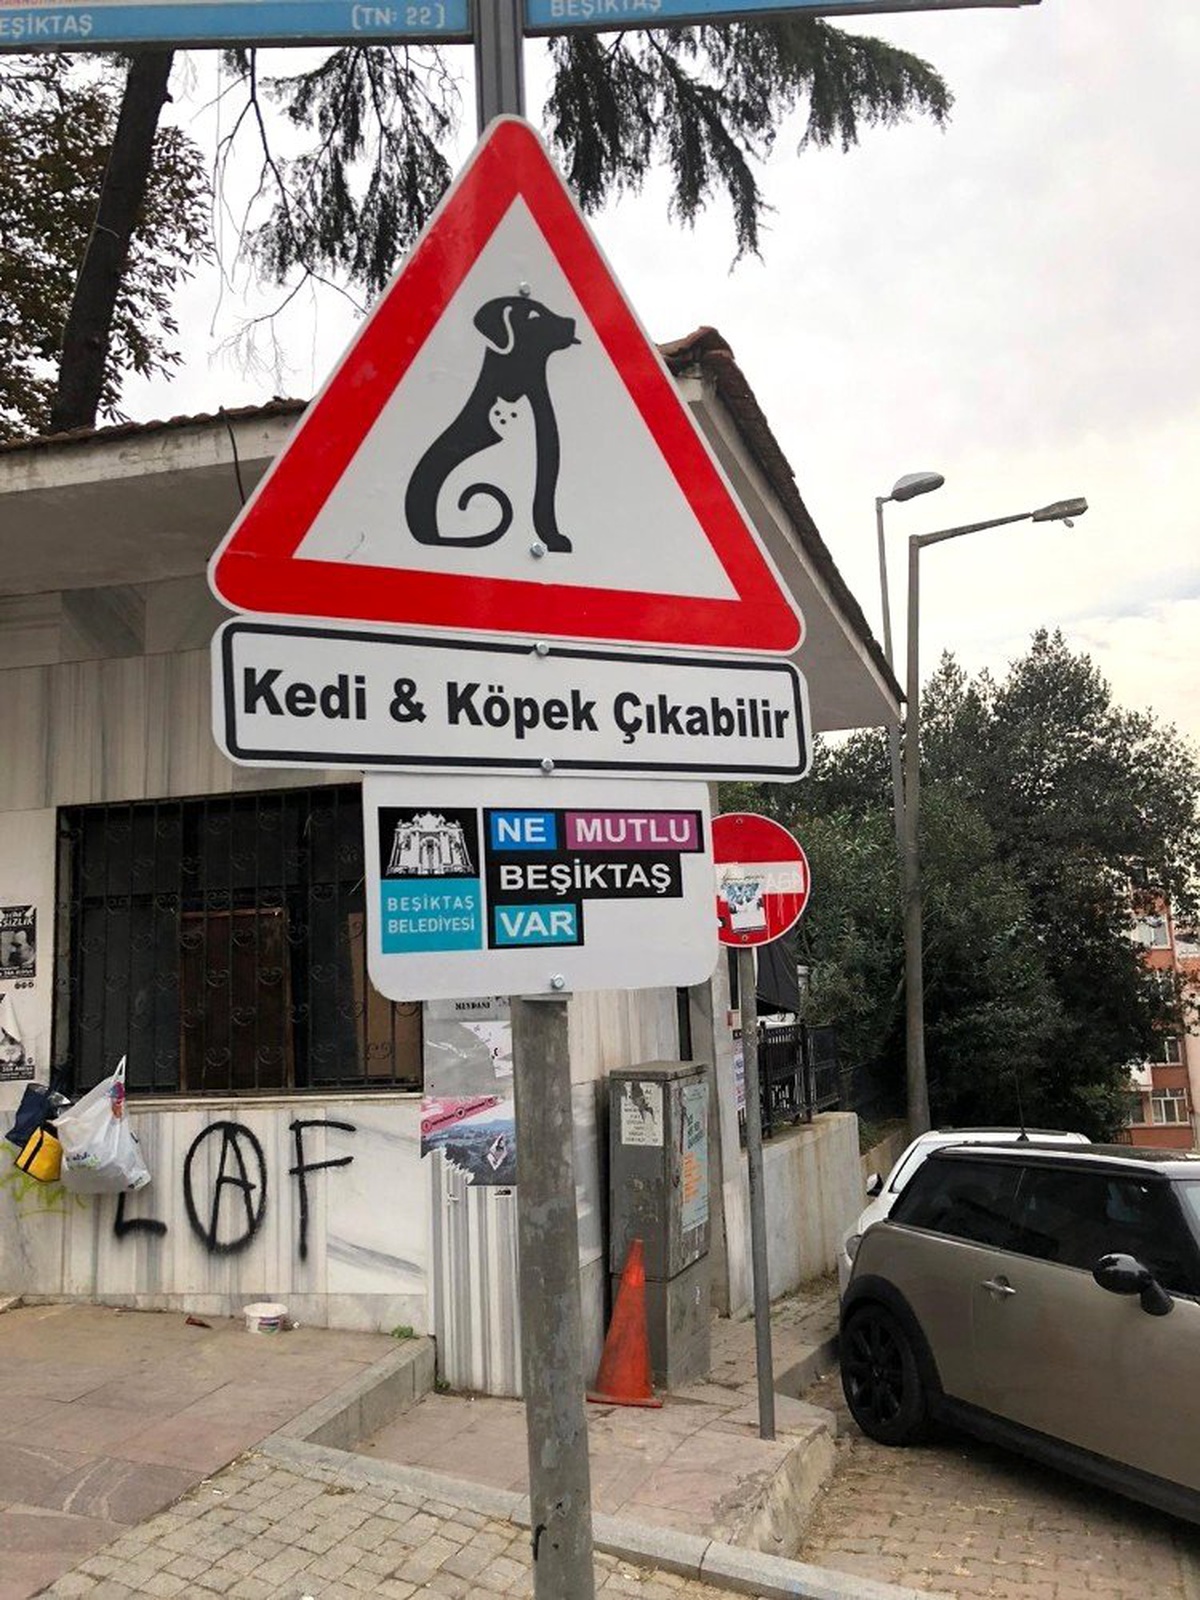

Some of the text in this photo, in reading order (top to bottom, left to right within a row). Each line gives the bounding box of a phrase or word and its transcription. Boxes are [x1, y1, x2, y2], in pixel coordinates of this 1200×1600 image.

[243, 667, 790, 744] Kedi & Köpek Çıkabilir
[498, 817, 691, 843] NE MUTLU
[500, 858, 672, 896] BEŞİKTAŞ
[387, 893, 475, 916] BEŞİKTAŞ
[387, 916, 476, 934] BELEDİYESİ
[499, 911, 574, 938] VAR
